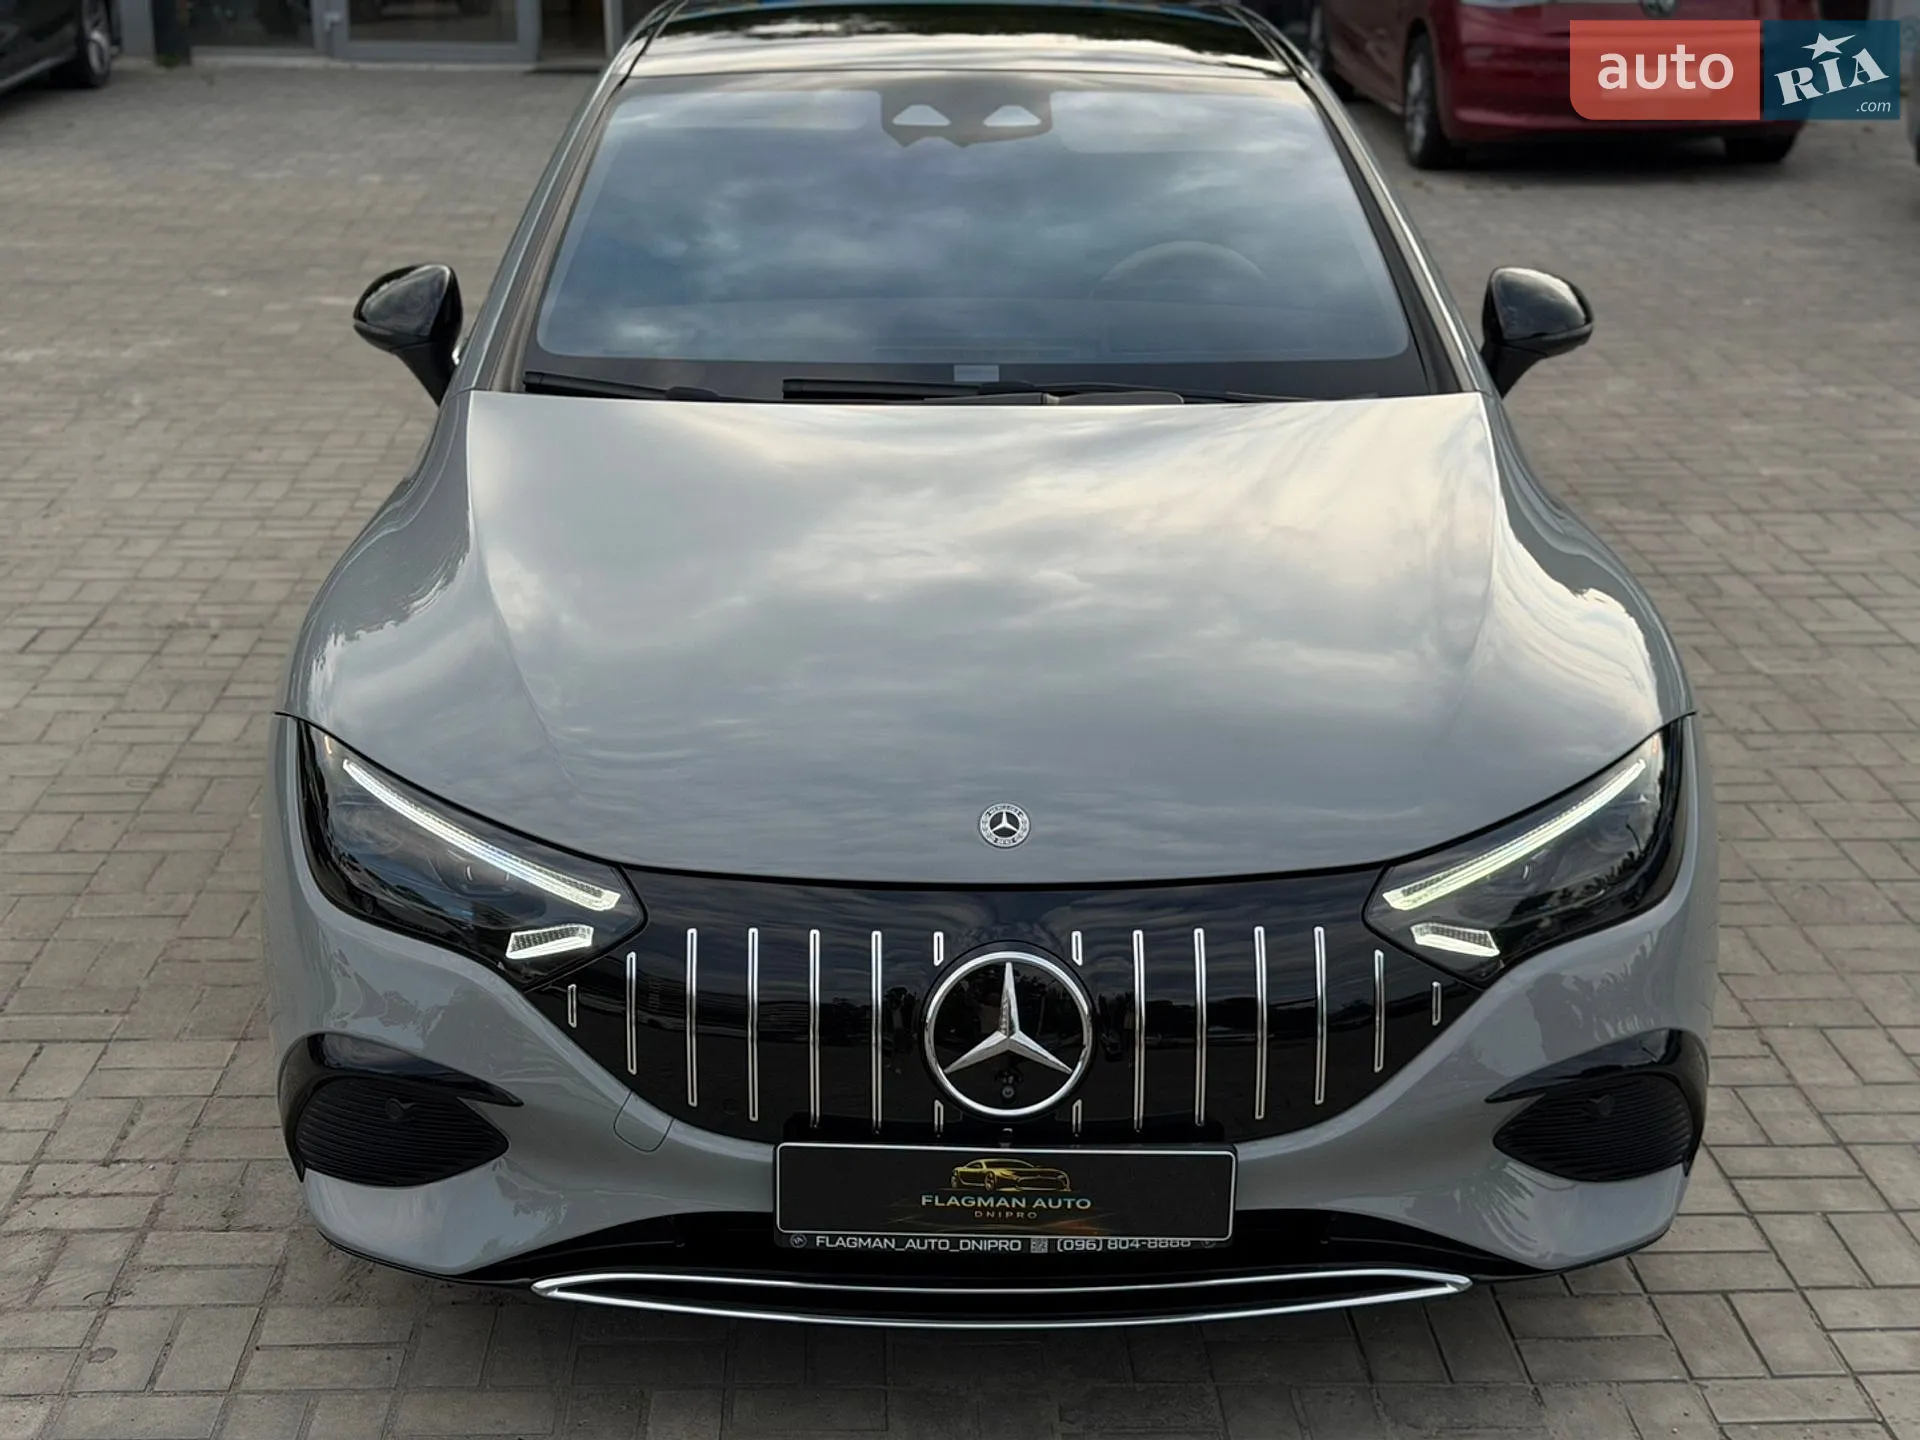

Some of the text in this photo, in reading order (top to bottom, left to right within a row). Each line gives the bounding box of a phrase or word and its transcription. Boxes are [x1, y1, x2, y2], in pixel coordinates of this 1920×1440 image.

[921, 1194, 1092, 1210] FLAGMAN AUTO
[974, 1210, 1038, 1220] DNIPRO
[816, 1235, 1022, 1252] FLAGMAN_AUTO_DNIPRO
[1057, 1238, 1102, 1252] (096)
